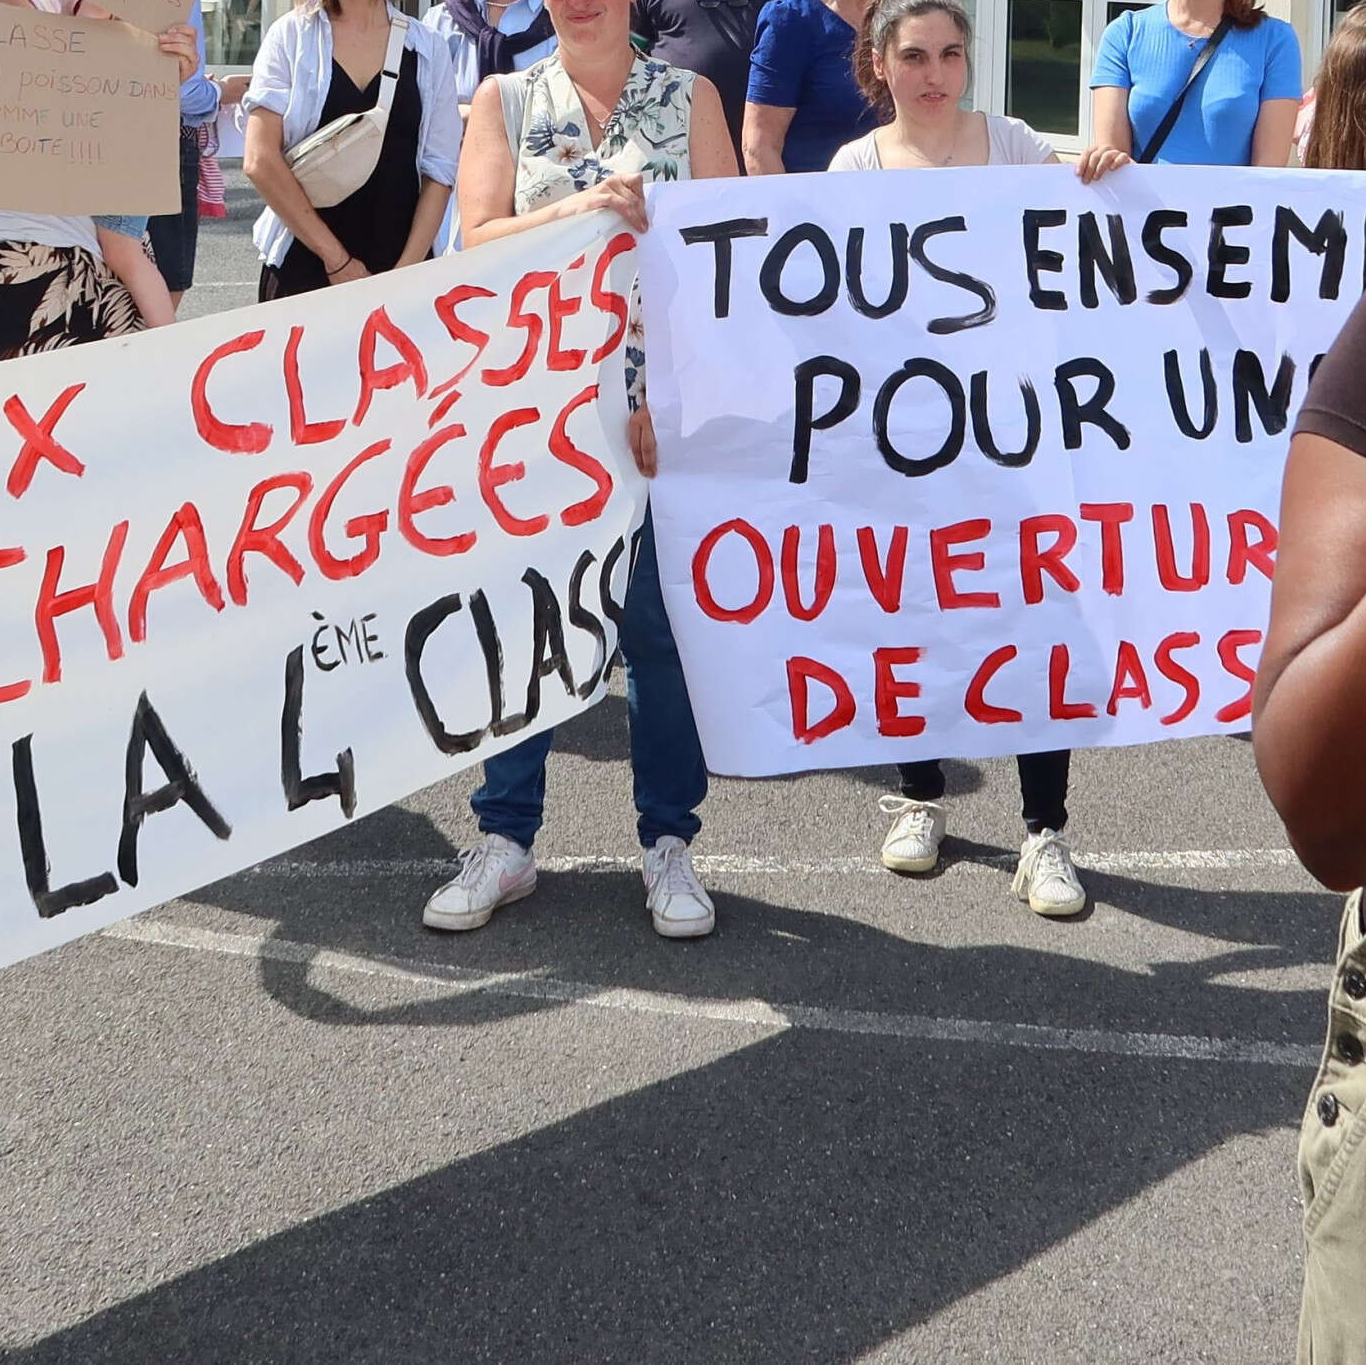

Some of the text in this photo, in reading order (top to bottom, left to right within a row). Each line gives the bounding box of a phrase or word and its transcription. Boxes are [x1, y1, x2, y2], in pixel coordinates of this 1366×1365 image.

[61, 110, 104, 129] UNE
[129, 80, 178, 102] DANS
[679, 216, 996, 334] TOUS
[192, 232, 637, 453] CLASSES
[789, 348, 1326, 484] POUR UN
[787, 647, 927, 744] DE
[12, 691, 232, 919] LA
